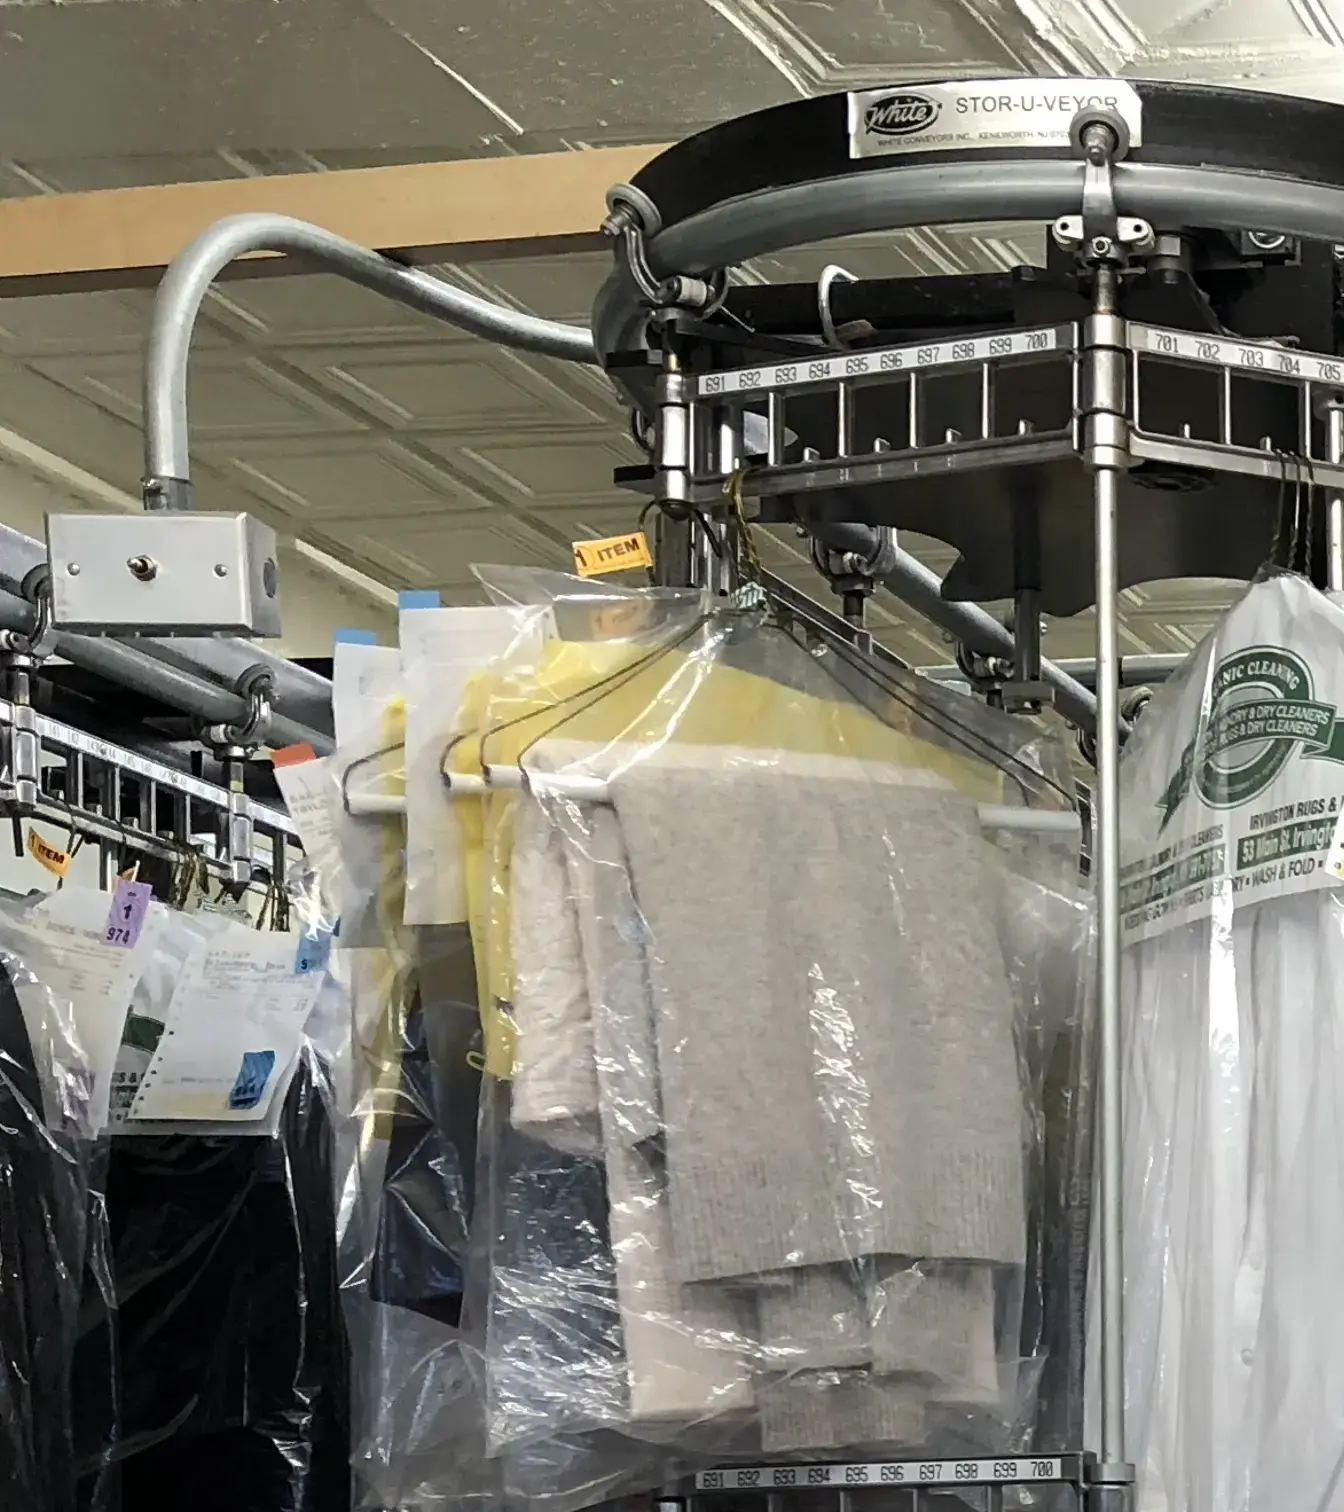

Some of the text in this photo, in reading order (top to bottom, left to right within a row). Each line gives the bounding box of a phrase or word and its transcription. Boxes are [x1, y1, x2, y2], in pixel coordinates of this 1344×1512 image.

[865, 97, 930, 131] White
[956, 95, 1119, 115] STOR-U-VEYOR
[705, 332, 1048, 393] 691 692 693 694 695 696 697 698 699 700
[1156, 335, 1179, 353] 701
[1195, 341, 1220, 361] 702
[1238, 348, 1264, 367] 703
[1278, 355, 1300, 373] 704
[1318, 361, 1341, 381] 705
[597, 537, 640, 562] ITEM
[1257, 703, 1330, 724] DRY CLEANERS
[1248, 720, 1318, 737] DRY CLEANERS
[1296, 800, 1325, 818] RUGS
[38, 843, 65, 865] ITEM
[1252, 857, 1315, 888] WASH FOLD
[106, 927, 130, 944] 974
[704, 1460, 1053, 1489] 691 692 693 694 695 696 697 698 699 700
